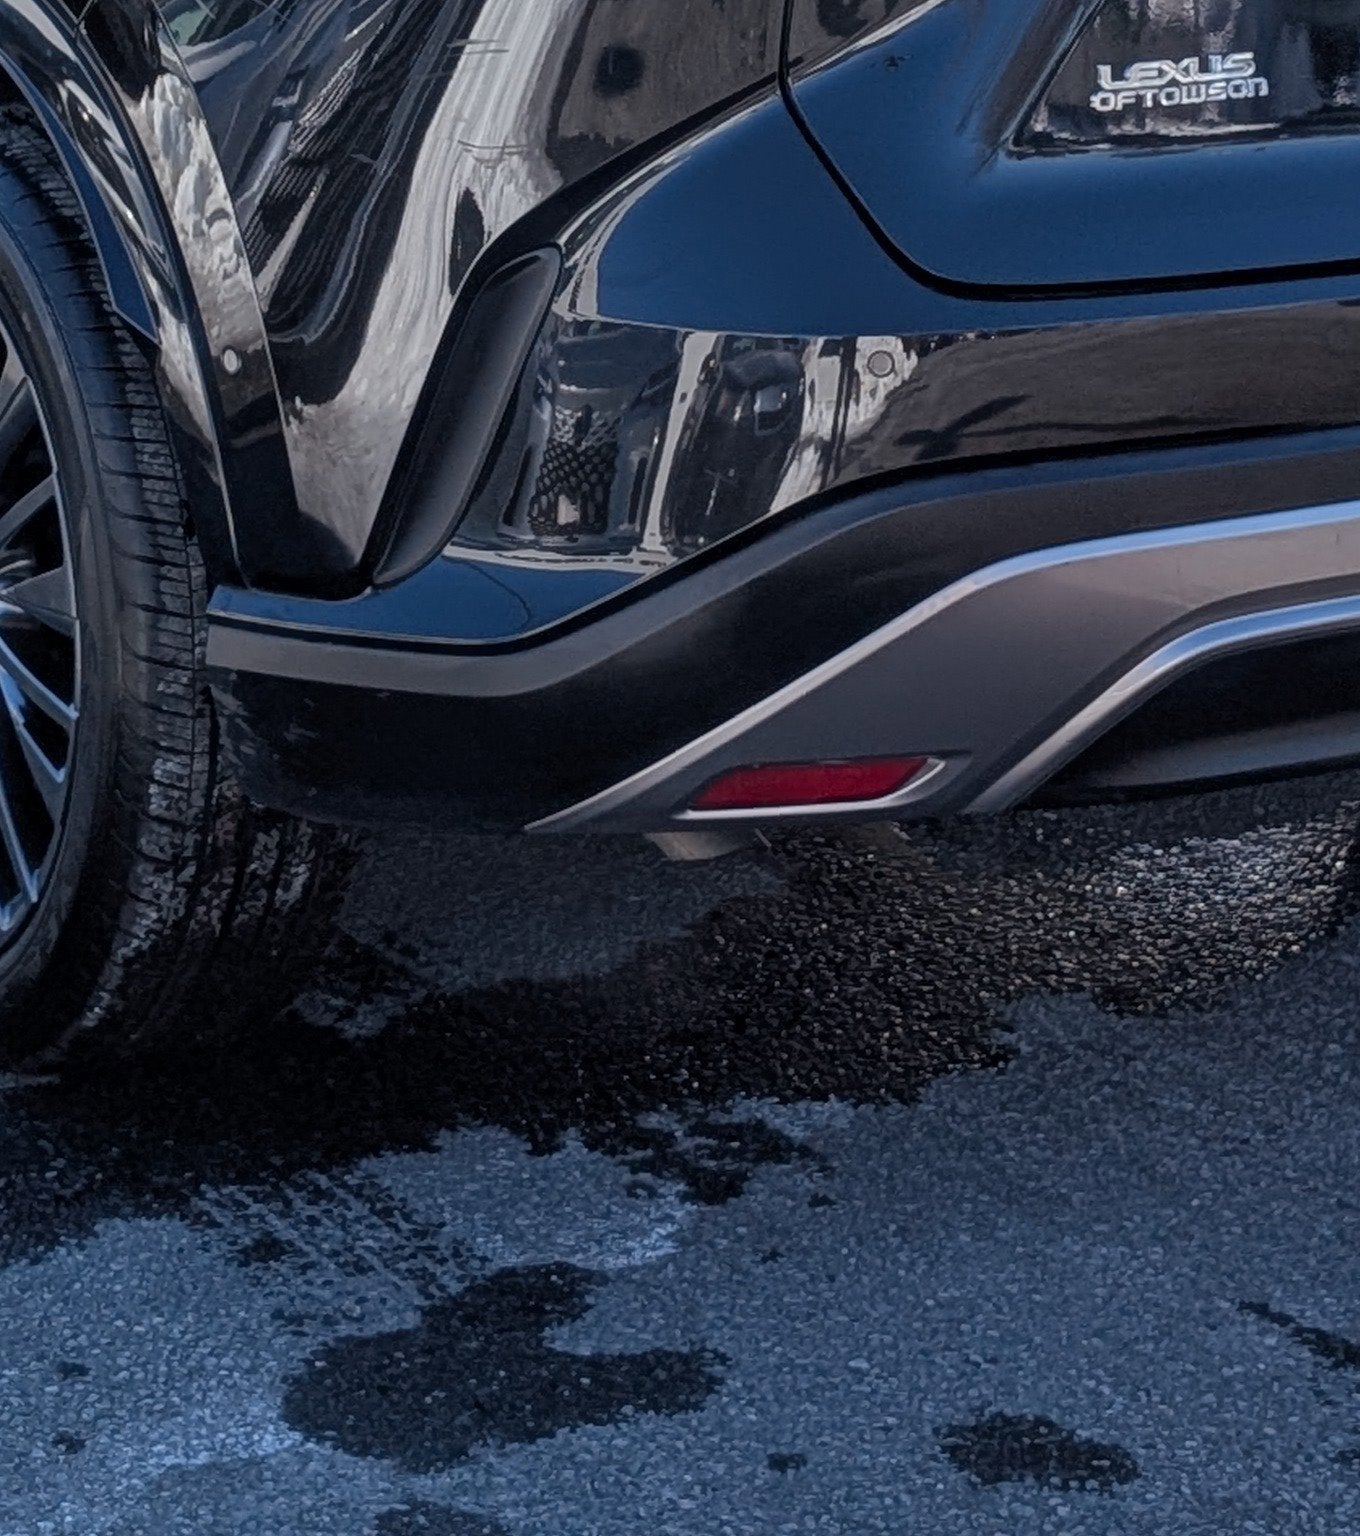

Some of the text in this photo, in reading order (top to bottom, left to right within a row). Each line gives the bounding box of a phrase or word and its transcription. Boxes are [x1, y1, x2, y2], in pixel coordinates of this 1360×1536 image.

[1096, 51, 1257, 91] LEXUS
[1093, 76, 1270, 113] OF TOWSON
